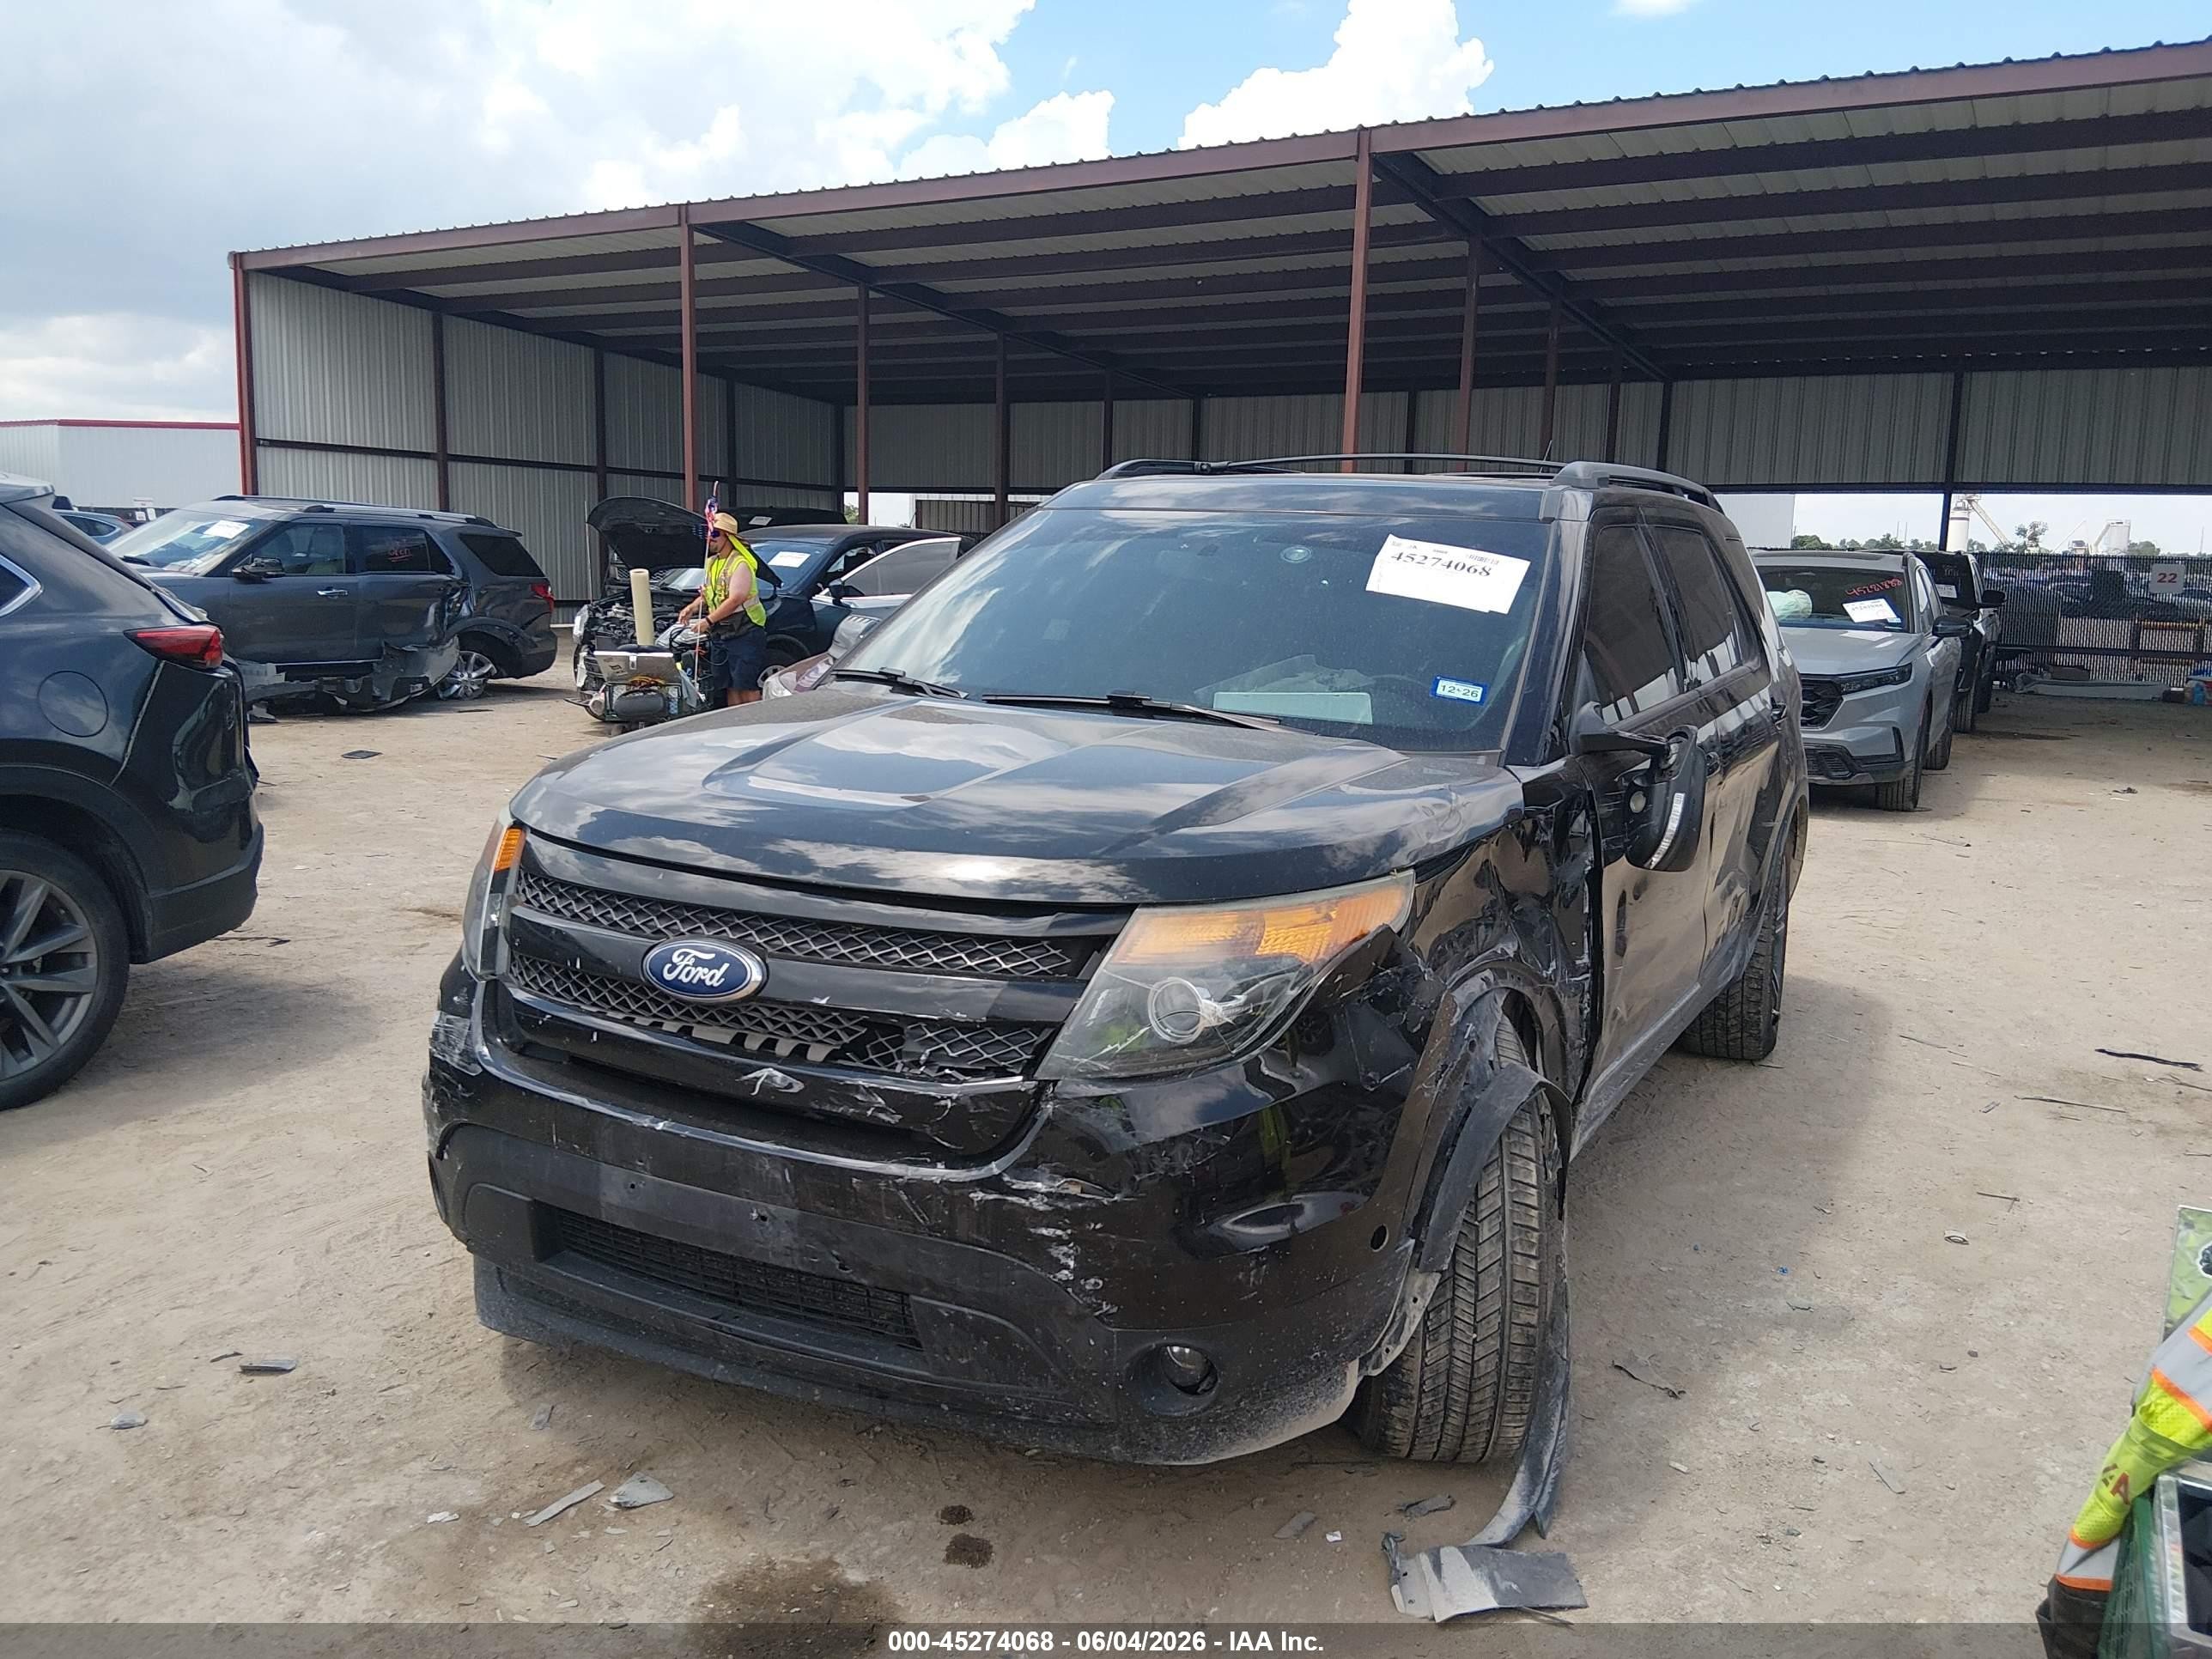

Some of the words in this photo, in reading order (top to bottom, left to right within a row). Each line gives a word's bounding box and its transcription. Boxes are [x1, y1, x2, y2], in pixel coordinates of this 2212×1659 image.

[1390, 551, 1492, 577] 45274068
[2156, 572, 2178, 583] 22
[662, 948, 731, 988] Ford
